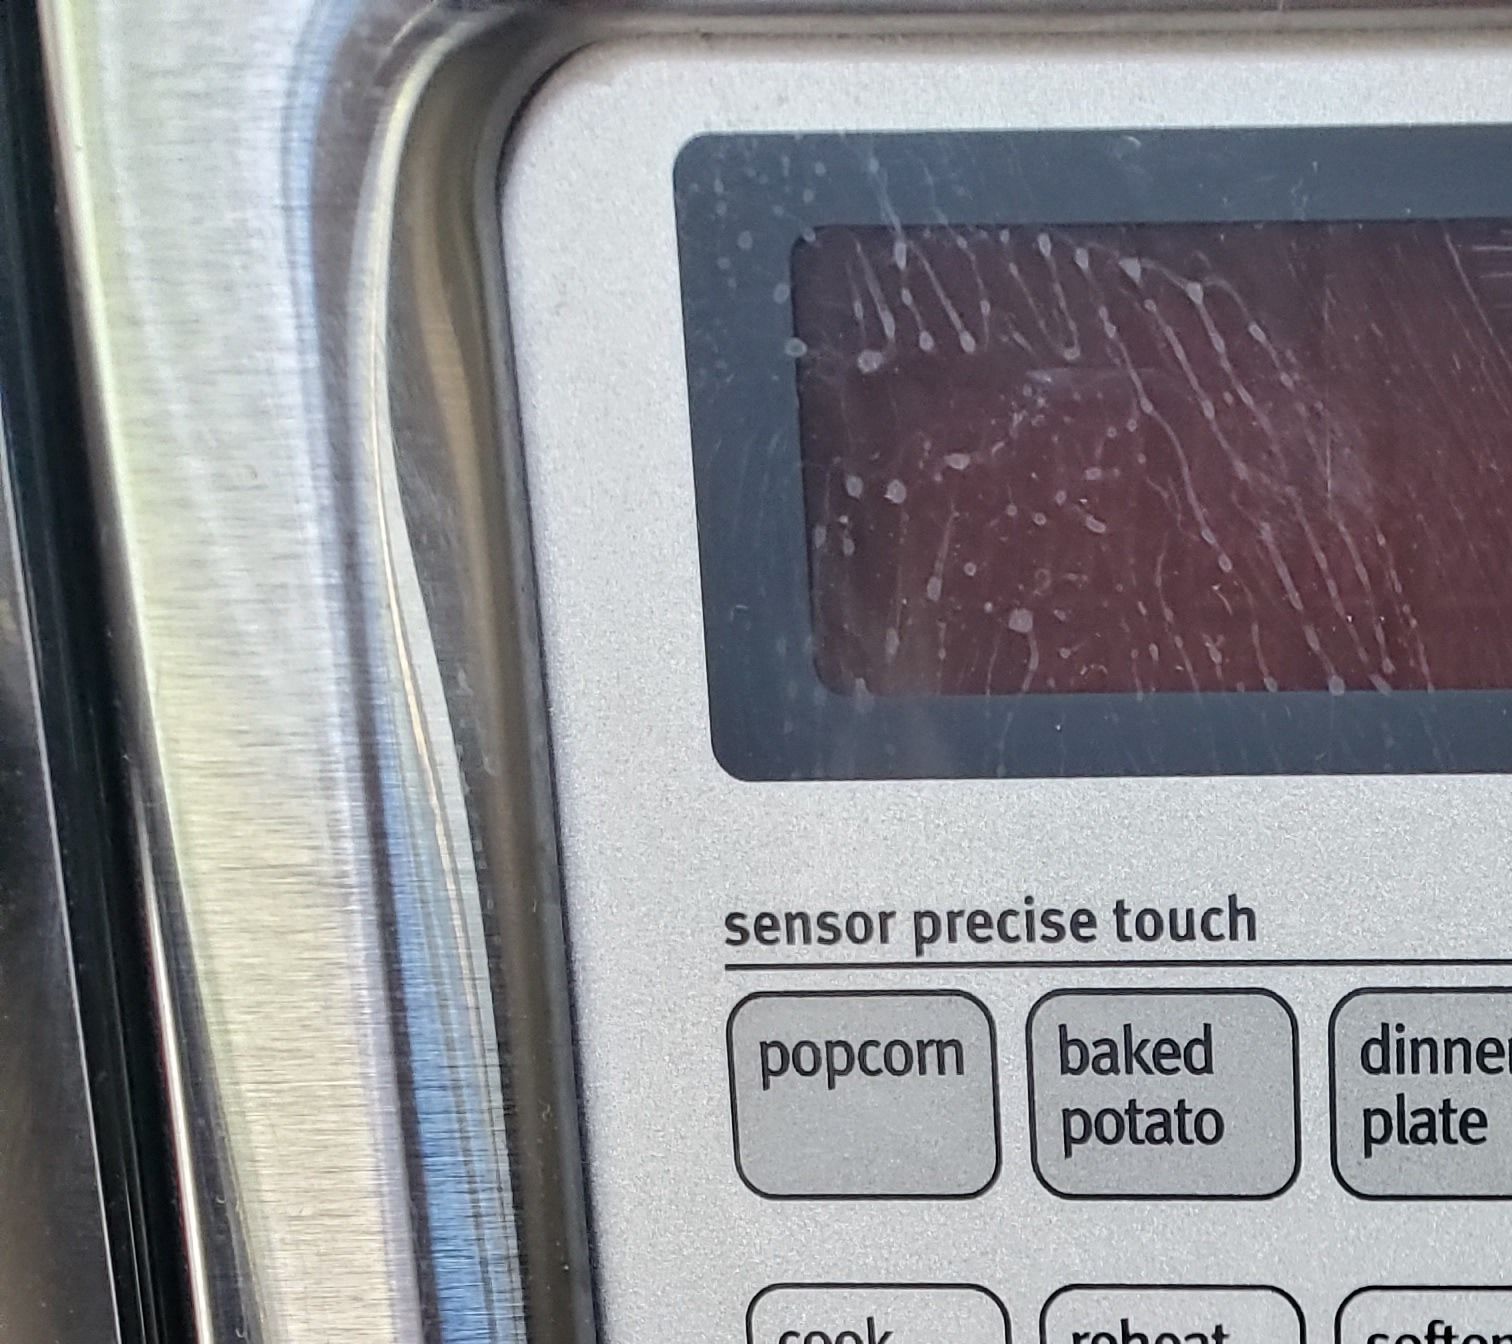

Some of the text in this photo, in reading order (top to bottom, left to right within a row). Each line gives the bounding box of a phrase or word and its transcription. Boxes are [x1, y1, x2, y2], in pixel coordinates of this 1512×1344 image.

[725, 893, 1256, 956] sensor precise touch
[760, 1039, 964, 1090] popcorn
[1058, 1023, 1213, 1075] baked
[1062, 1099, 1224, 1159] potato
[1363, 1093, 1488, 1158] plate
